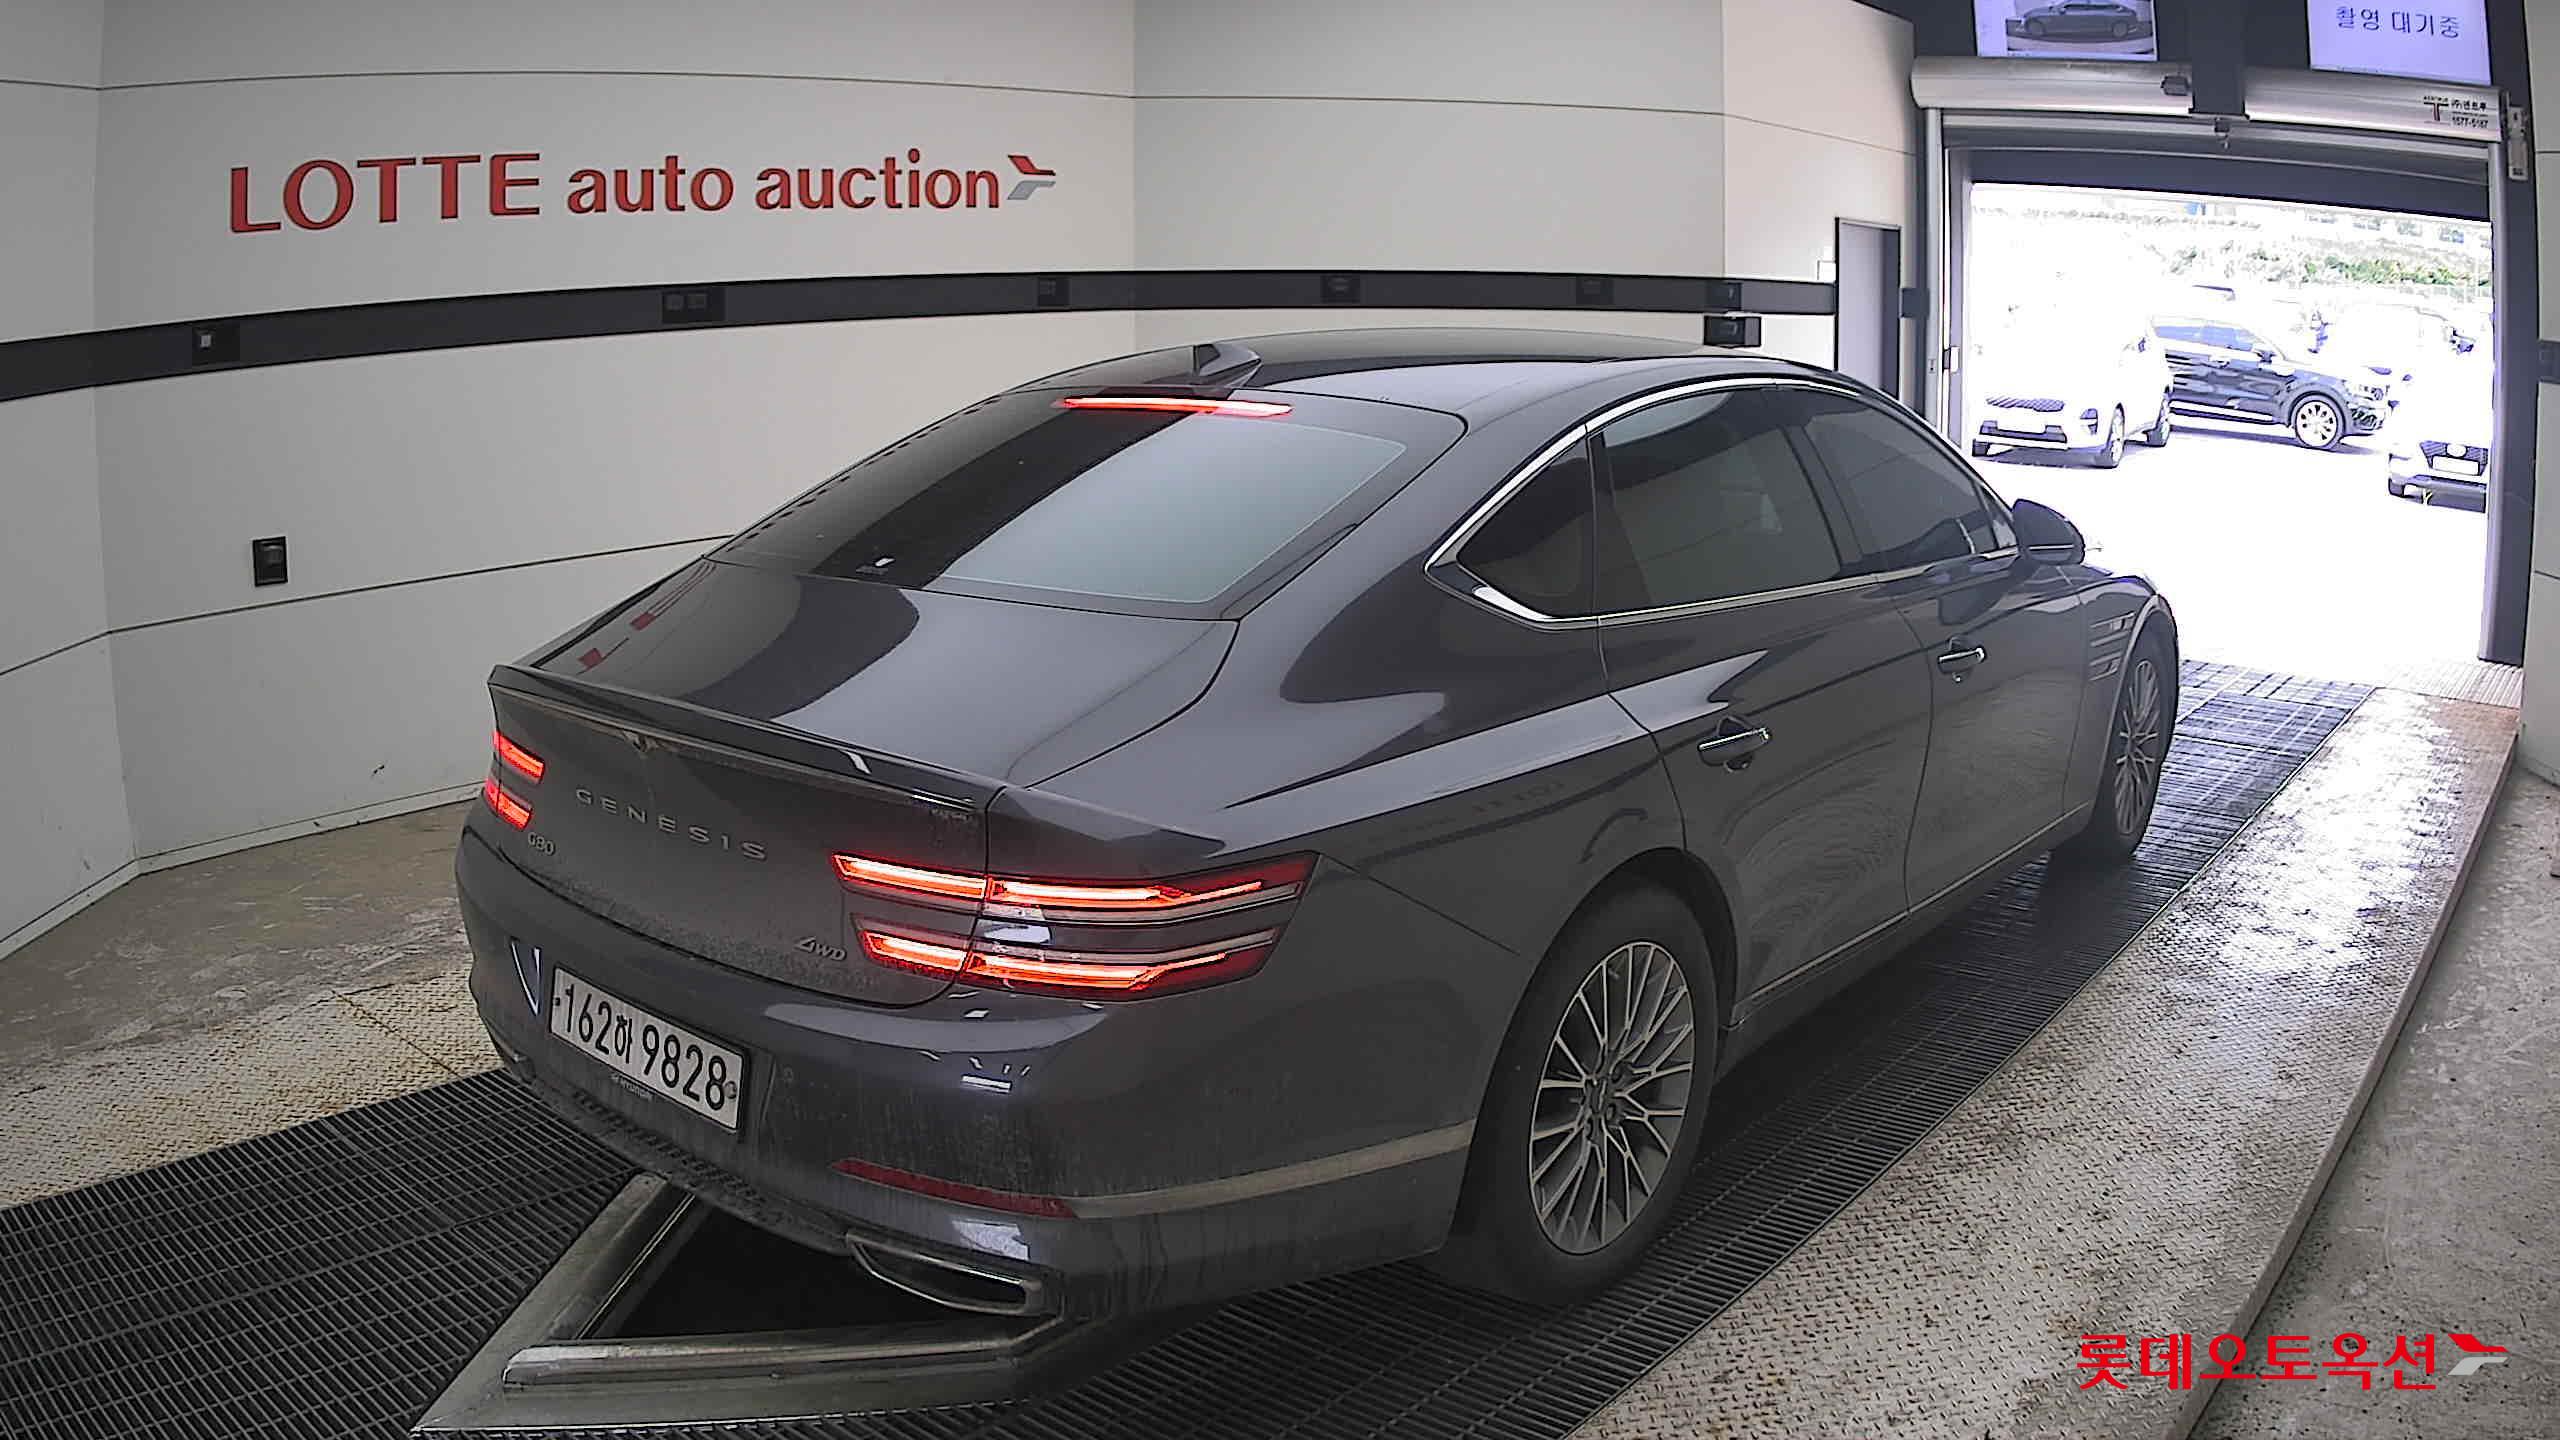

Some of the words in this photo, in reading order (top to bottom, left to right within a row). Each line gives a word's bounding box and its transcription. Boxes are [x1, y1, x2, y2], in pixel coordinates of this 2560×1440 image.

[2337, 6, 2380, 31] 촬영
[2391, 11, 2459, 38] 대기중
[230, 152, 541, 234] LOTTE
[567, 154, 734, 214] auto
[755, 147, 1001, 211] auction
[527, 831, 556, 857] G80
[575, 788, 767, 861] GENESIS
[793, 936, 847, 961] 4WD
[565, 984, 633, 1064] 162하
[642, 1024, 727, 1111] 9828
